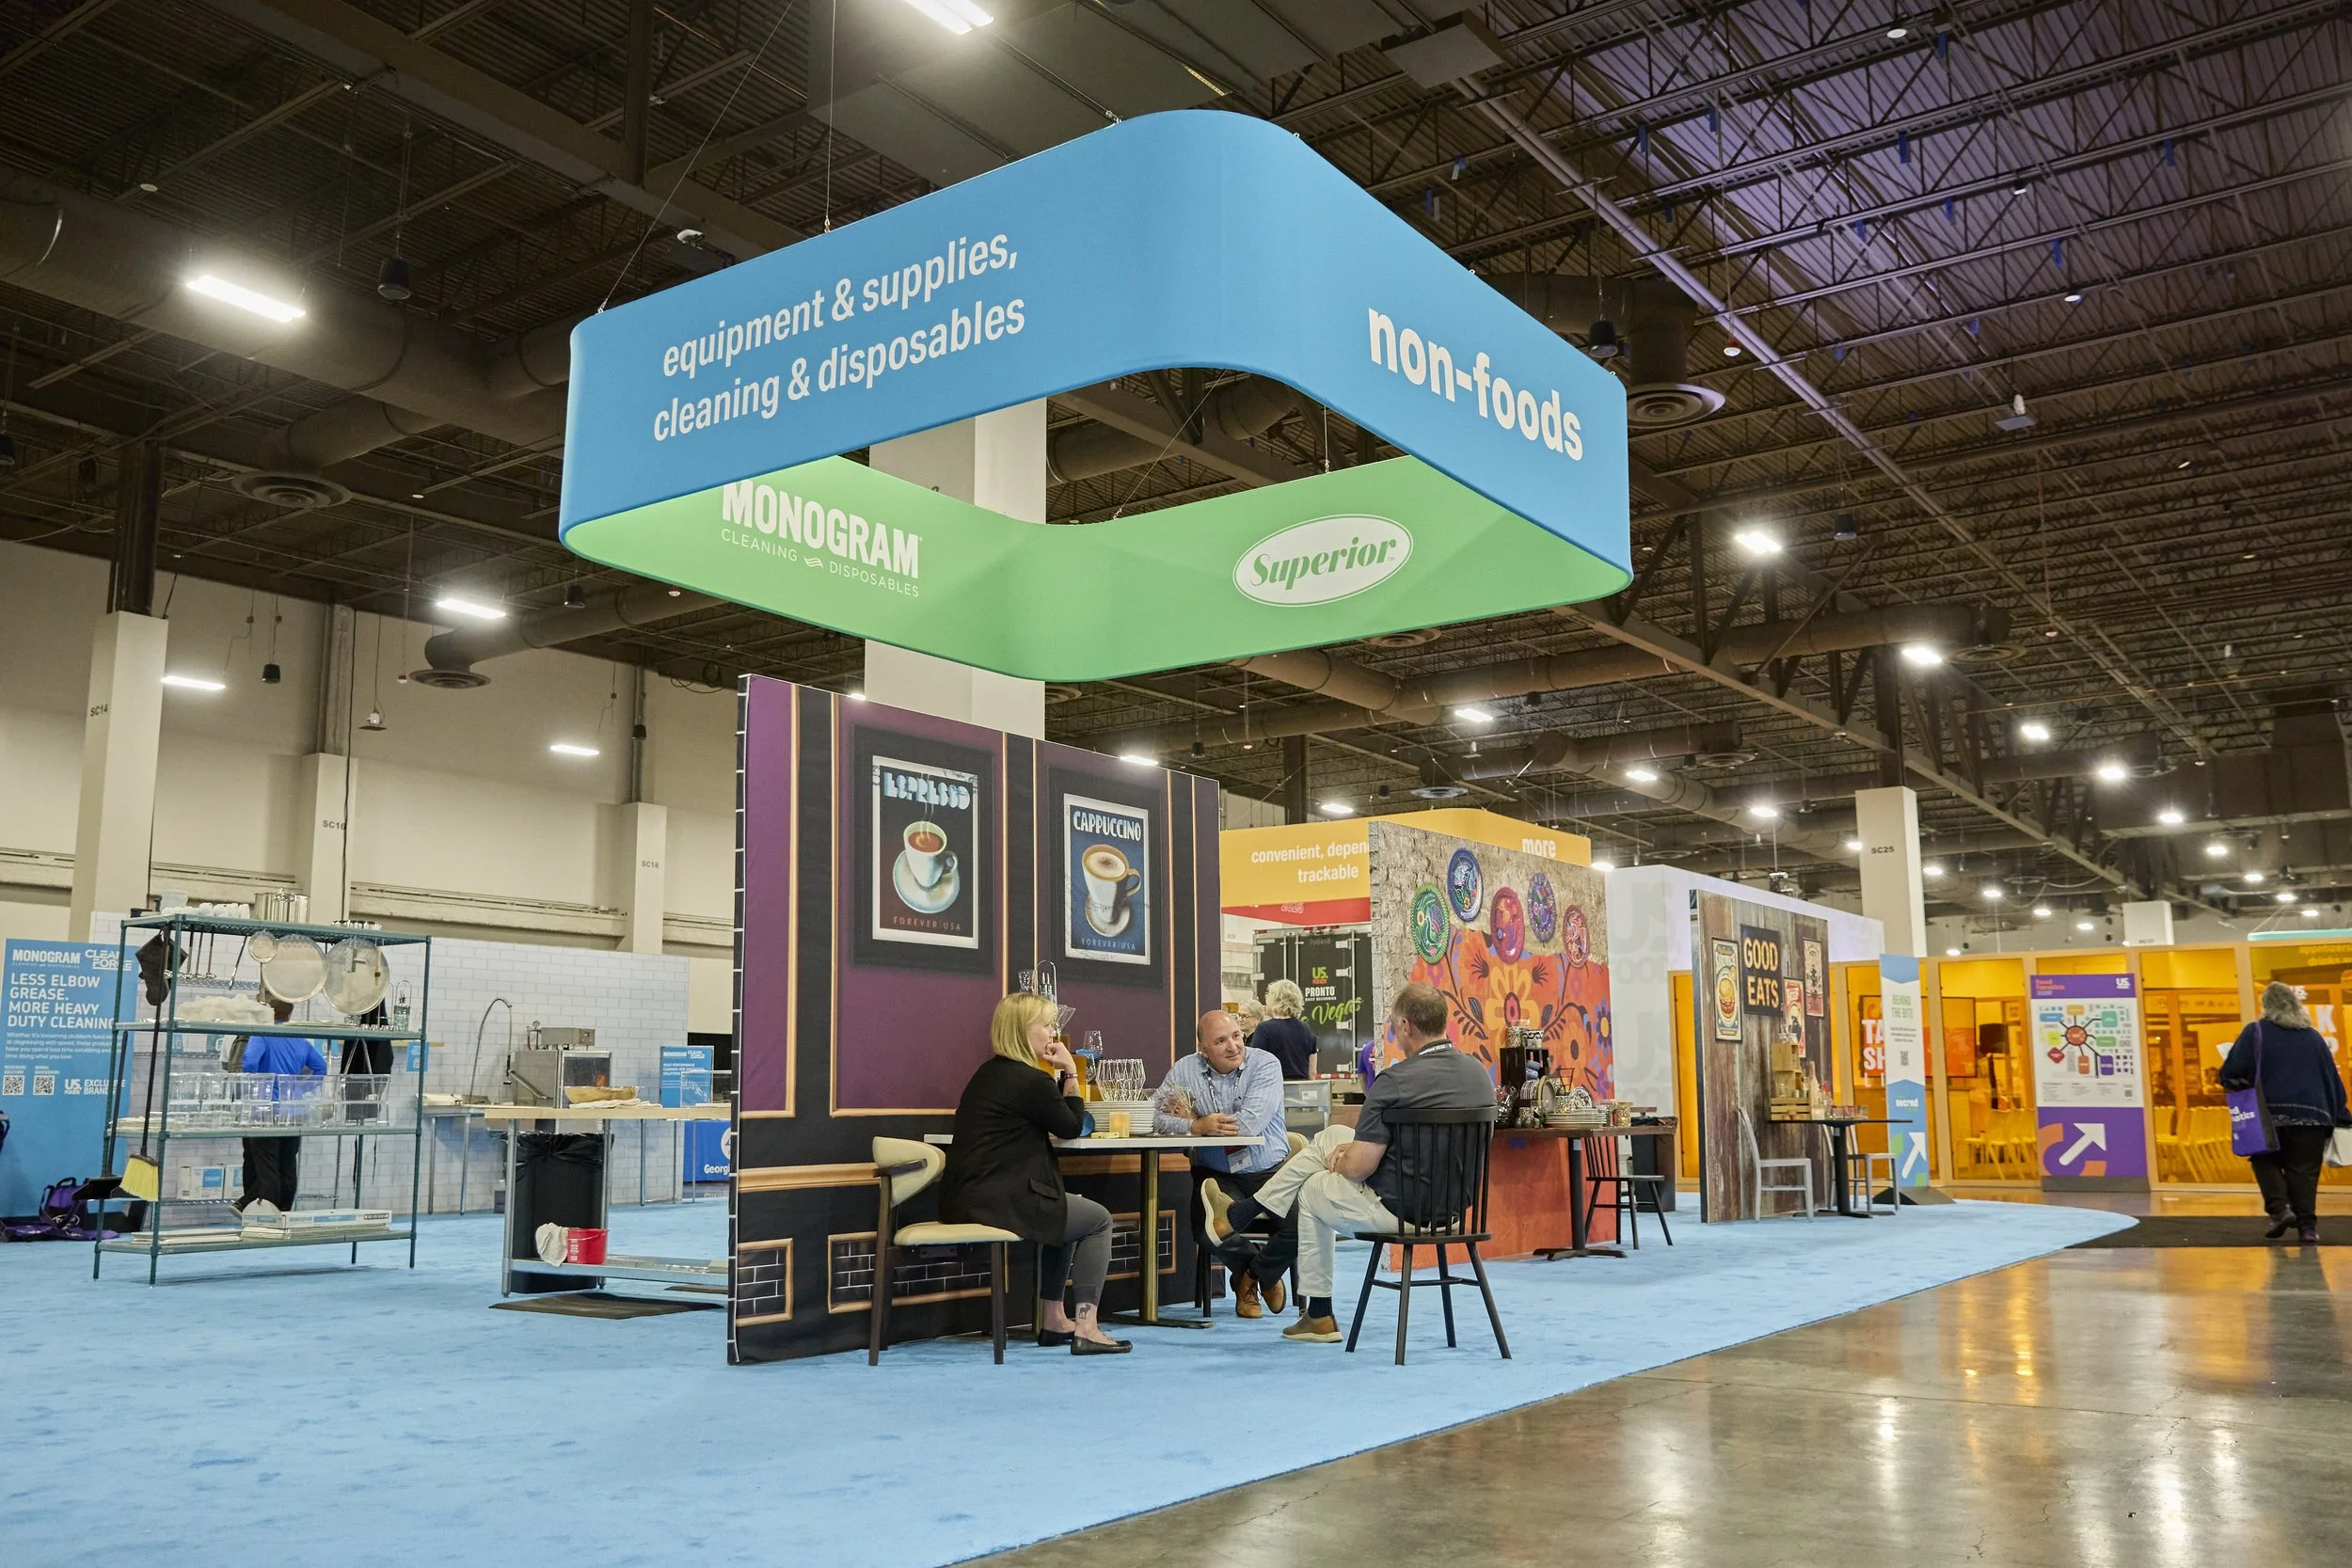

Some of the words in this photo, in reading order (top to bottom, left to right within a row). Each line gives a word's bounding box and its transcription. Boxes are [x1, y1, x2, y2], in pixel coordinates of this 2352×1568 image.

[663, 289, 824, 379] equipment
[832, 278, 855, 322] &
[863, 233, 1018, 311] supplies,
[654, 372, 780, 441] cleaning
[787, 357, 811, 401] &
[818, 299, 1025, 393] disposables
[1368, 308, 1582, 461] non-foods
[722, 480, 921, 578] MONOGRAM
[722, 529, 798, 562] CLEANING
[829, 560, 920, 597] DISPOSABLES
[1249, 536, 1397, 591] Superior
[883, 771, 970, 810] ESPRESSO
[1073, 811, 1141, 842] CAPPUCCINO
[1251, 845, 1324, 863] convenient,
[1521, 838, 1556, 859] more
[1871, 846, 1894, 854] SC25
[1297, 863, 1359, 883] trackable
[894, 916, 937, 928] FOREVER
[943, 922, 961, 931] USA
[1082, 937, 1118, 950] FOREVER
[1120, 942, 1136, 951] USA
[12, 949, 81, 964] MONOGRAM
[1743, 937, 1778, 972] GOOD
[92, 959, 132, 969] FORE
[1311, 966, 1328, 979] US.
[11, 973, 46, 986] LESS
[51, 974, 101, 988] ELBOW
[9, 987, 69, 1001] GREASE.
[1305, 986, 1335, 997] PRONTO
[1747, 975, 1779, 1008] EATS
[8, 1001, 50, 1014] MORE
[55, 1003, 100, 1016] HEAVY
[1311, 997, 1363, 1024] Vegas
[8, 1015, 47, 1027] DUTY
[64, 1078, 82, 1090] US.
[85, 1079, 127, 1087] EXCLUIE
[704, 1164, 730, 1176] Georgi
